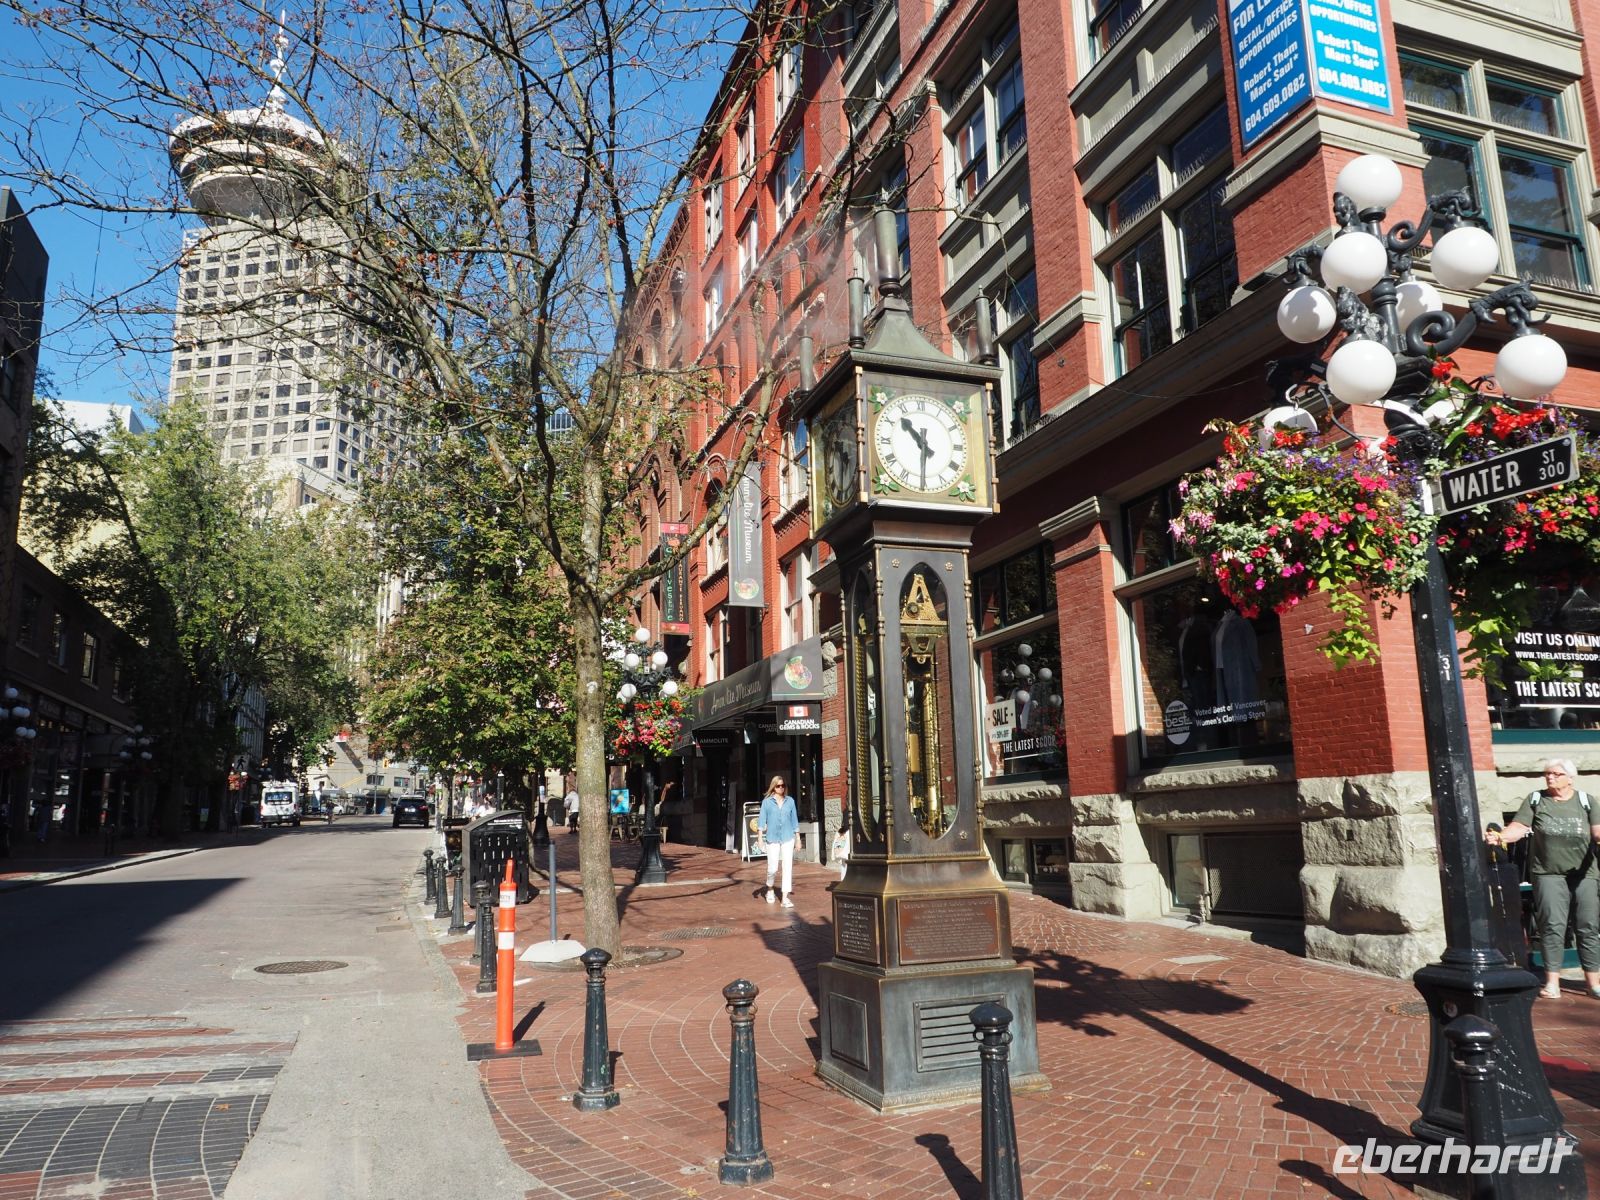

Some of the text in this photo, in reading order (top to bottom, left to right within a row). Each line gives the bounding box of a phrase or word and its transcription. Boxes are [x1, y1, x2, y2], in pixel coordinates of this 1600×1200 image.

[1234, 3, 1255, 35] FOR
[1310, 4, 1377, 33] OPPORTUNITIES
[1320, 0, 1373, 17] L/OFFICE
[1239, 0, 1294, 53] RETAIL/OFFICE
[1239, 10, 1298, 69] OPPORTUNITIES
[1316, 29, 1379, 59] Robert Tham
[1324, 45, 1352, 64] Marc
[1244, 41, 1298, 93] Robert Tham
[1250, 78, 1272, 103] Marc
[1245, 73, 1306, 133] 604.609.0882
[1541, 448, 1556, 465] ST
[1449, 460, 1565, 504] WATER 300
[743, 519, 755, 563] Museum
[1514, 632, 1600, 648] VISIT US ONLIN
[1515, 651, 1600, 661] WWW.THELATESTSCOOP.
[735, 680, 762, 702] Museum
[1515, 681, 1600, 698] THE LATEST SC
[992, 706, 1009, 727] SALE
[1195, 707, 1212, 717] Voted
[1213, 705, 1226, 714] Best
[1226, 703, 1233, 711] of
[1234, 700, 1266, 709] Vancouver
[1195, 716, 1222, 727] Women's
[1222, 713, 1247, 723] Clothing
[1248, 711, 1265, 720] Store
[1003, 742, 1013, 753] THE
[1014, 738, 1034, 751] LATEST
